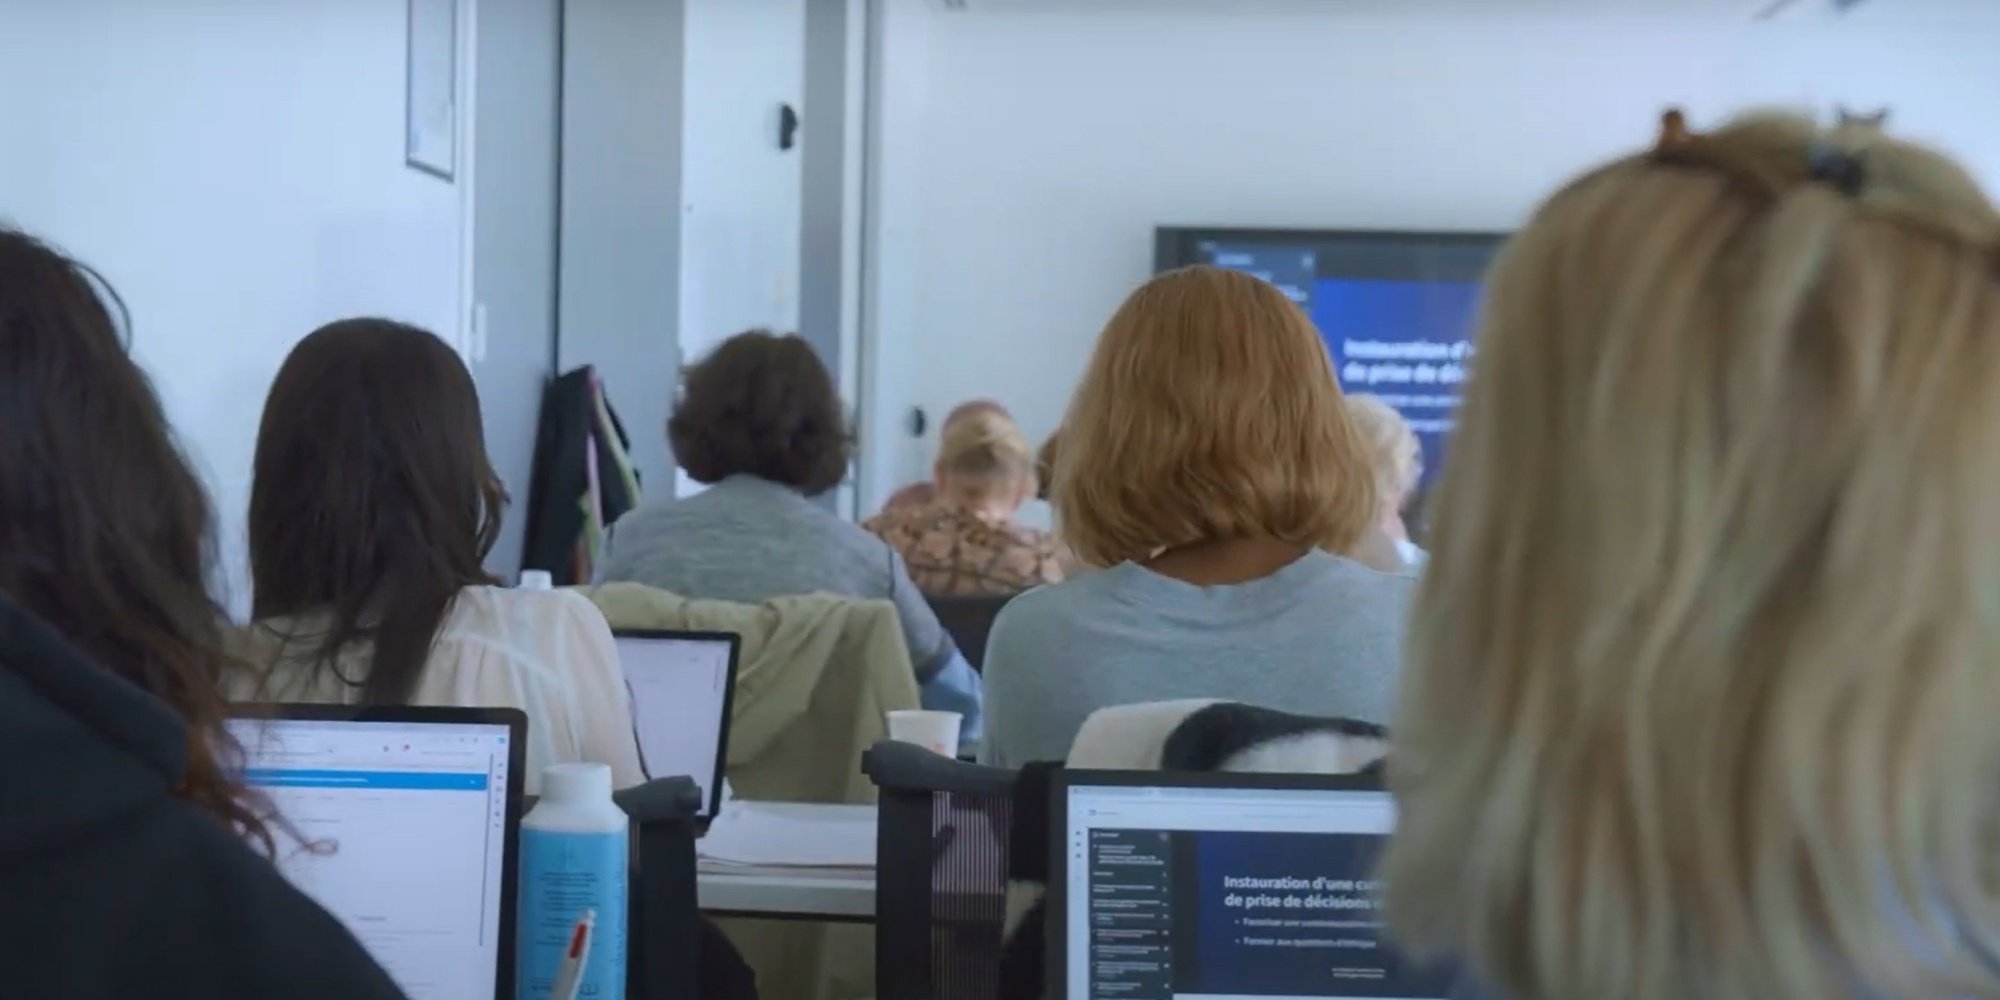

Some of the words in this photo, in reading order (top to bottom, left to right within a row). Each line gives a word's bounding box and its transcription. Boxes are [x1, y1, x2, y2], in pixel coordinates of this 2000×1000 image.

[1343, 361, 1366, 382] de
[1413, 362, 1437, 383] de
[1224, 876, 1310, 890] Instauration
[1312, 876, 1354, 891] d'une
[1224, 893, 1243, 906] de
[1245, 893, 1281, 909] prise
[1283, 894, 1302, 908] de
[1304, 894, 1371, 910] décisions
